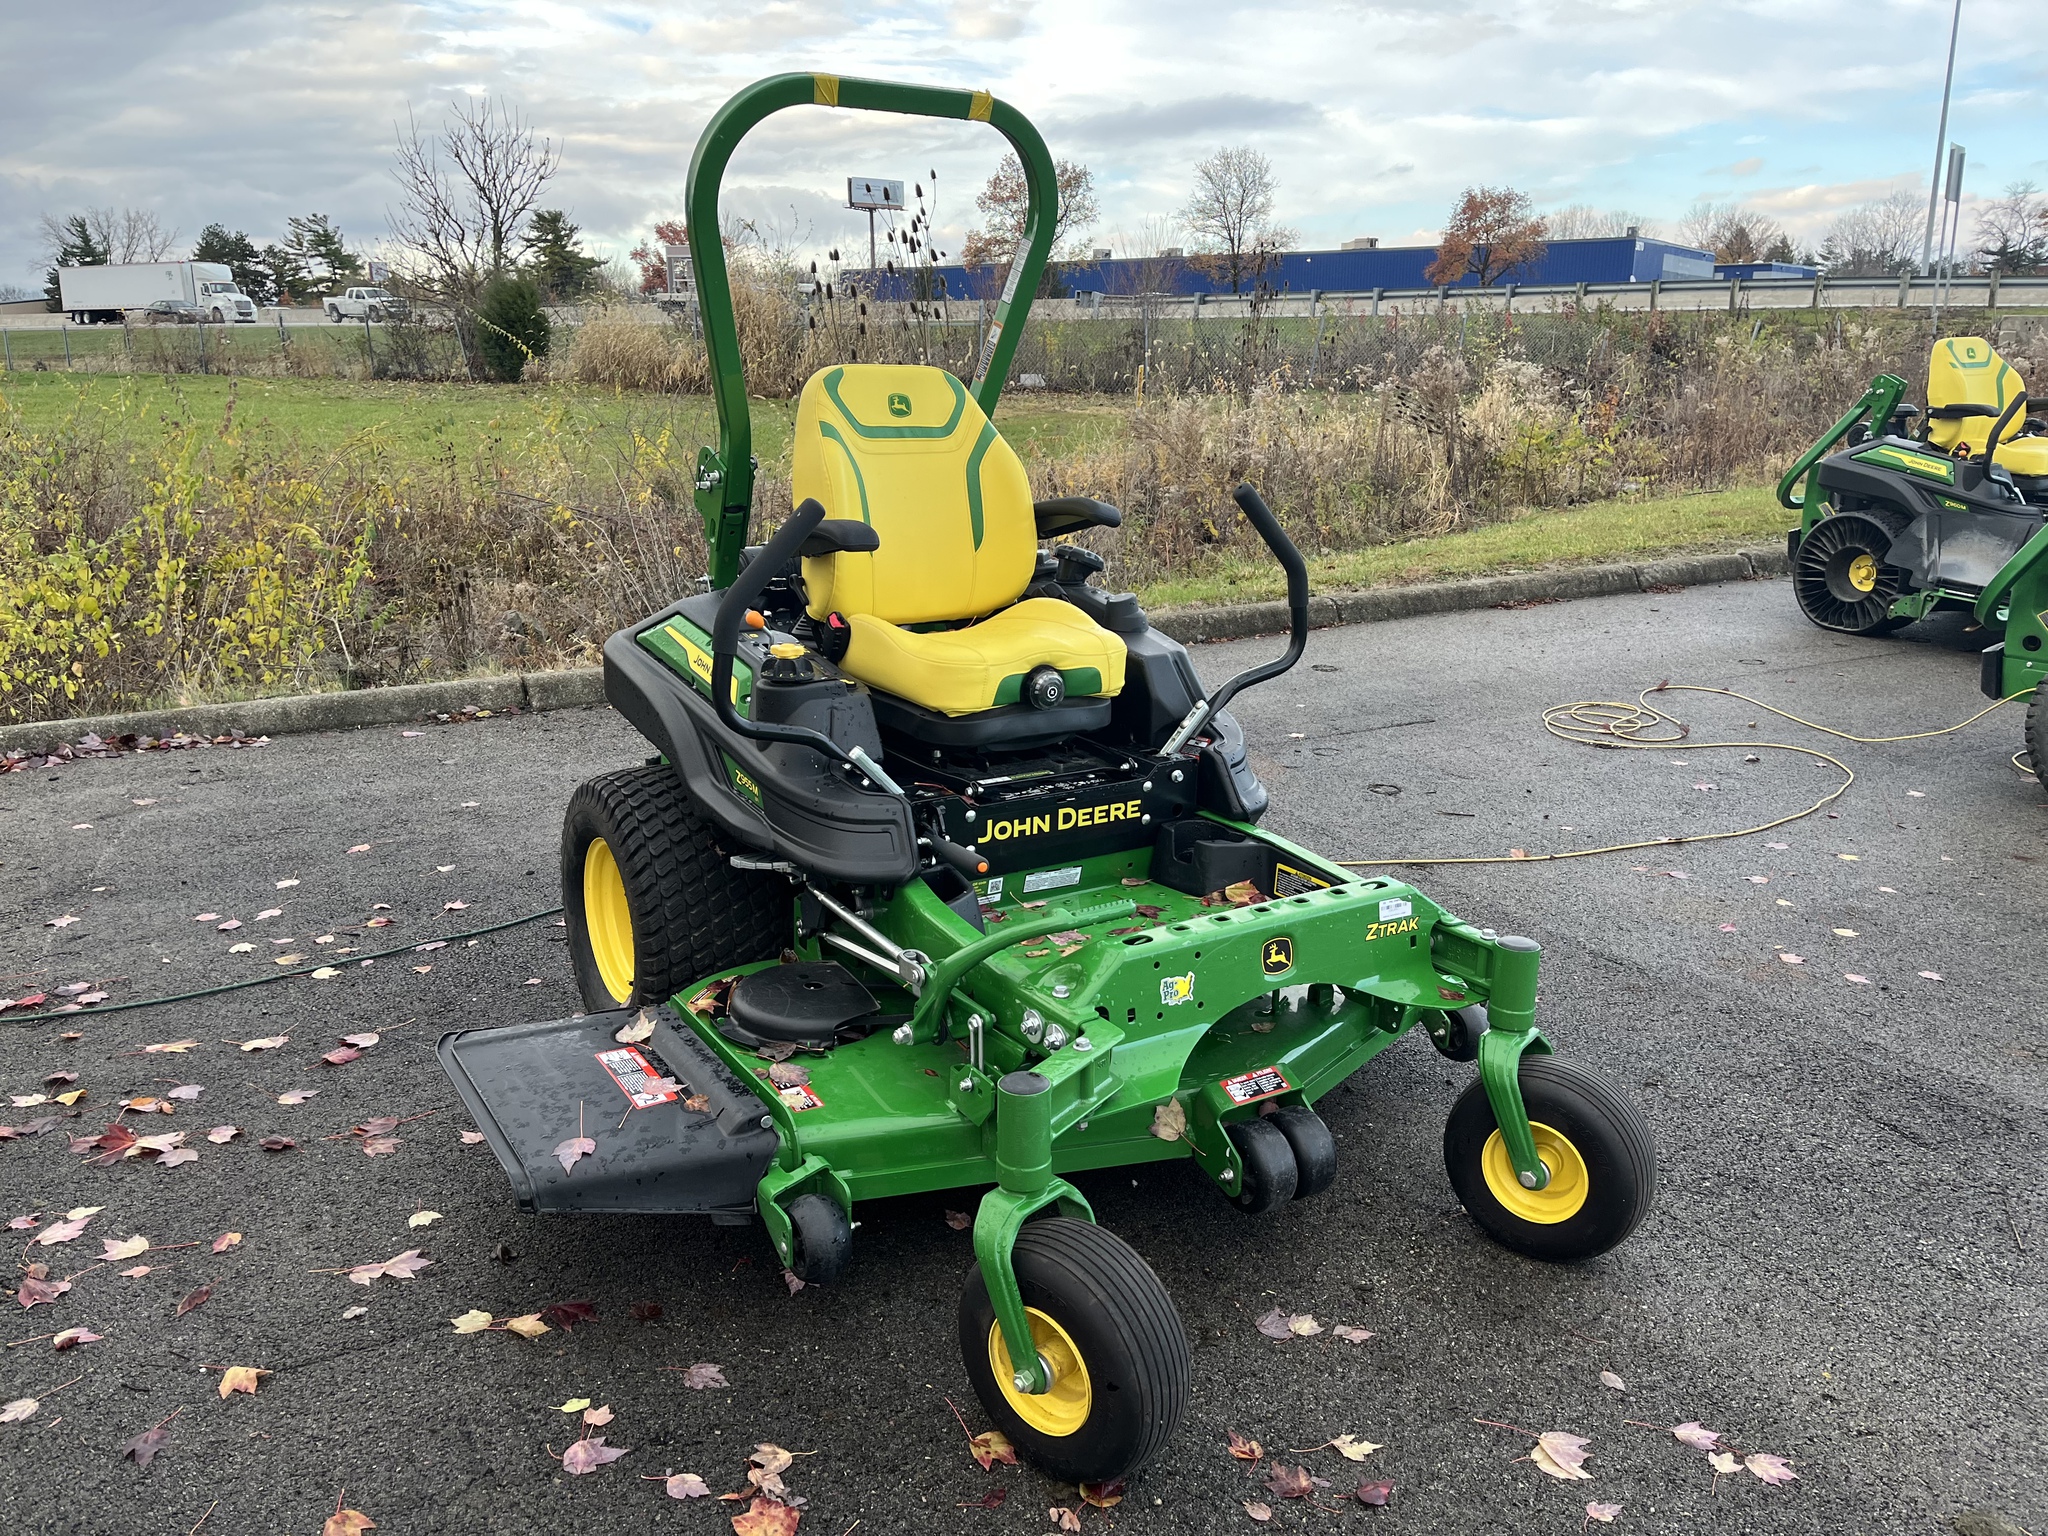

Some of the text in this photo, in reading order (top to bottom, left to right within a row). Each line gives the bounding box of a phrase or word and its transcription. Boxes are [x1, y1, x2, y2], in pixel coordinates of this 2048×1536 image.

[1923, 463, 1942, 472] DEERE
[693, 654, 711, 674] JOHN
[977, 799, 1142, 844] JOHN DEERE
[1365, 916, 1420, 941] ZTRAK
[1163, 989, 1179, 1001] Pro
